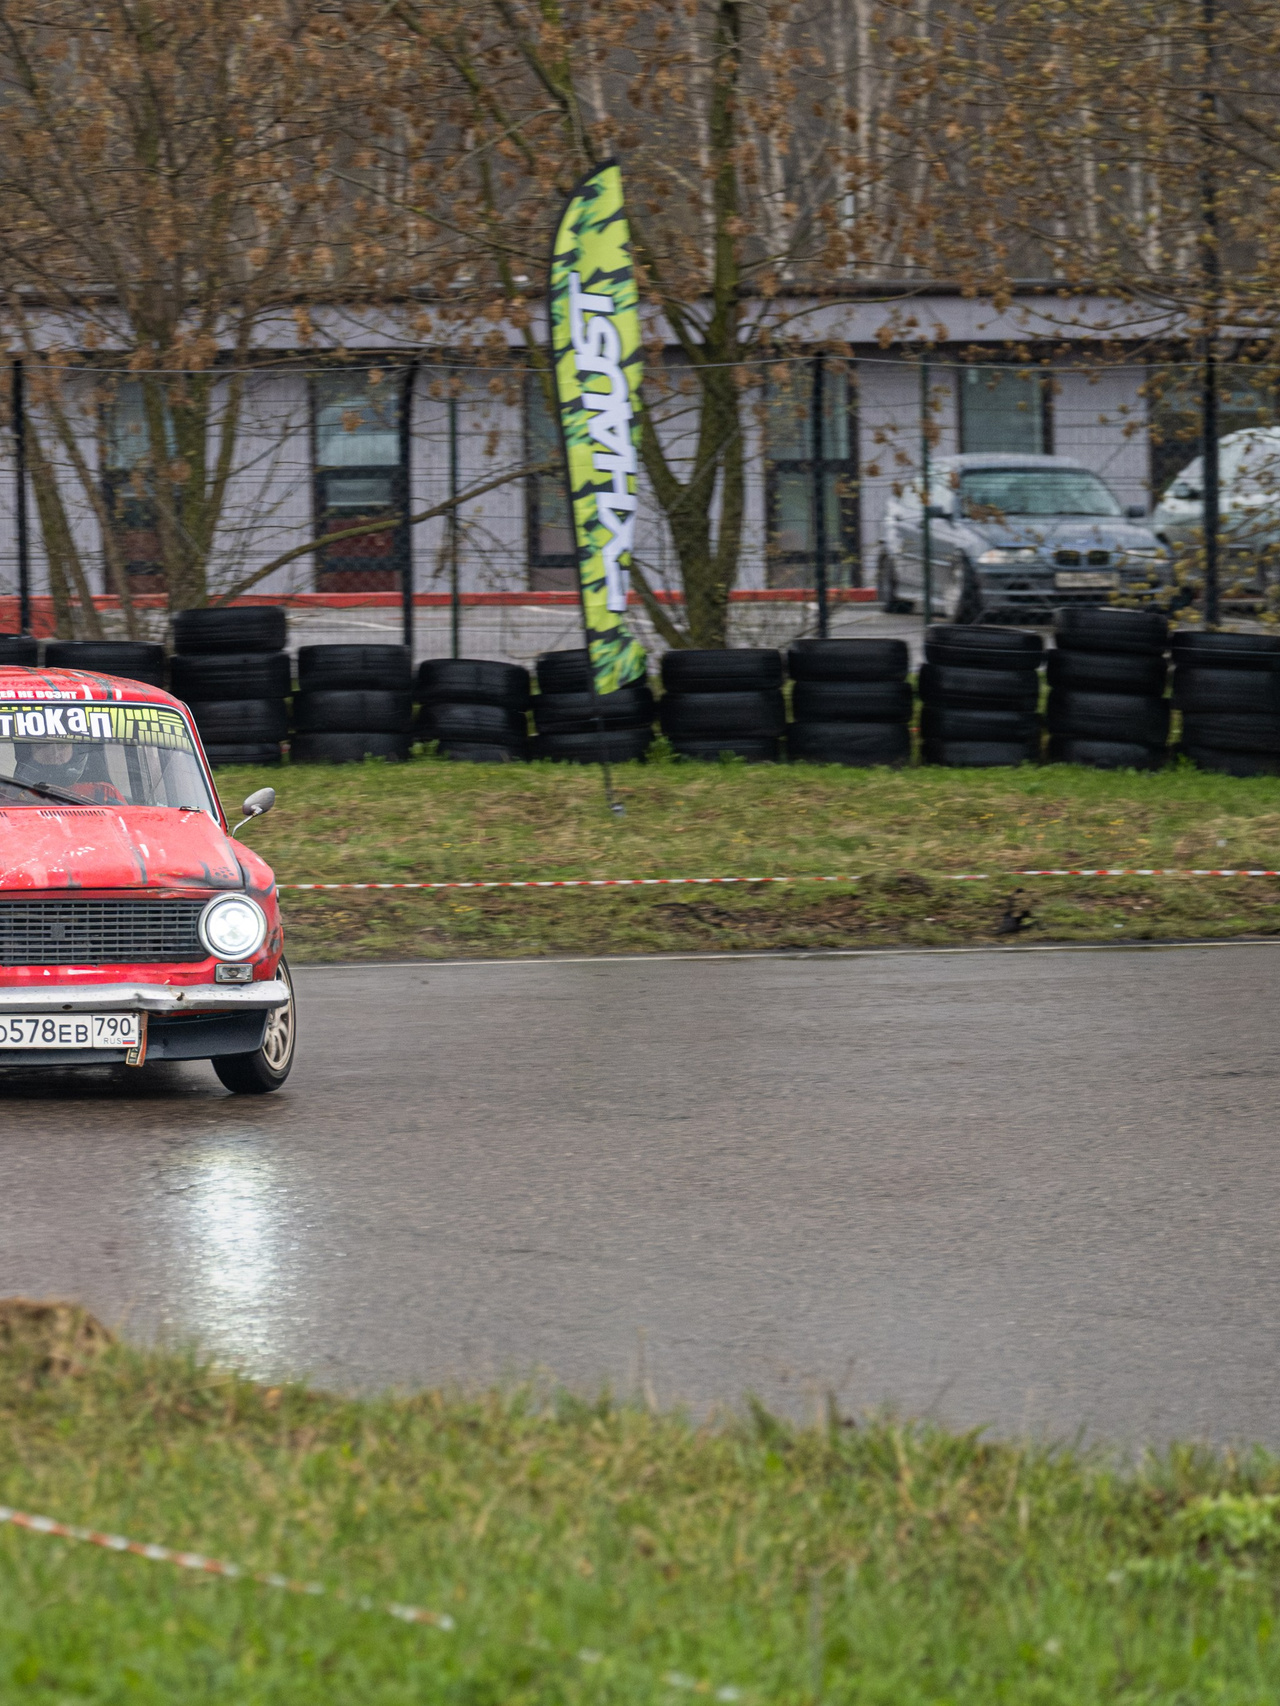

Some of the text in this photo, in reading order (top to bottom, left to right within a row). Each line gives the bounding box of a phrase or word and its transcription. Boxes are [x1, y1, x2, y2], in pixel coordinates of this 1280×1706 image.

[17, 690, 34, 698] НЕ
[35, 690, 77, 699] ВОЗИТ
[94, 1017, 131, 1037] 790
[103, 1037, 122, 1045] RUS
